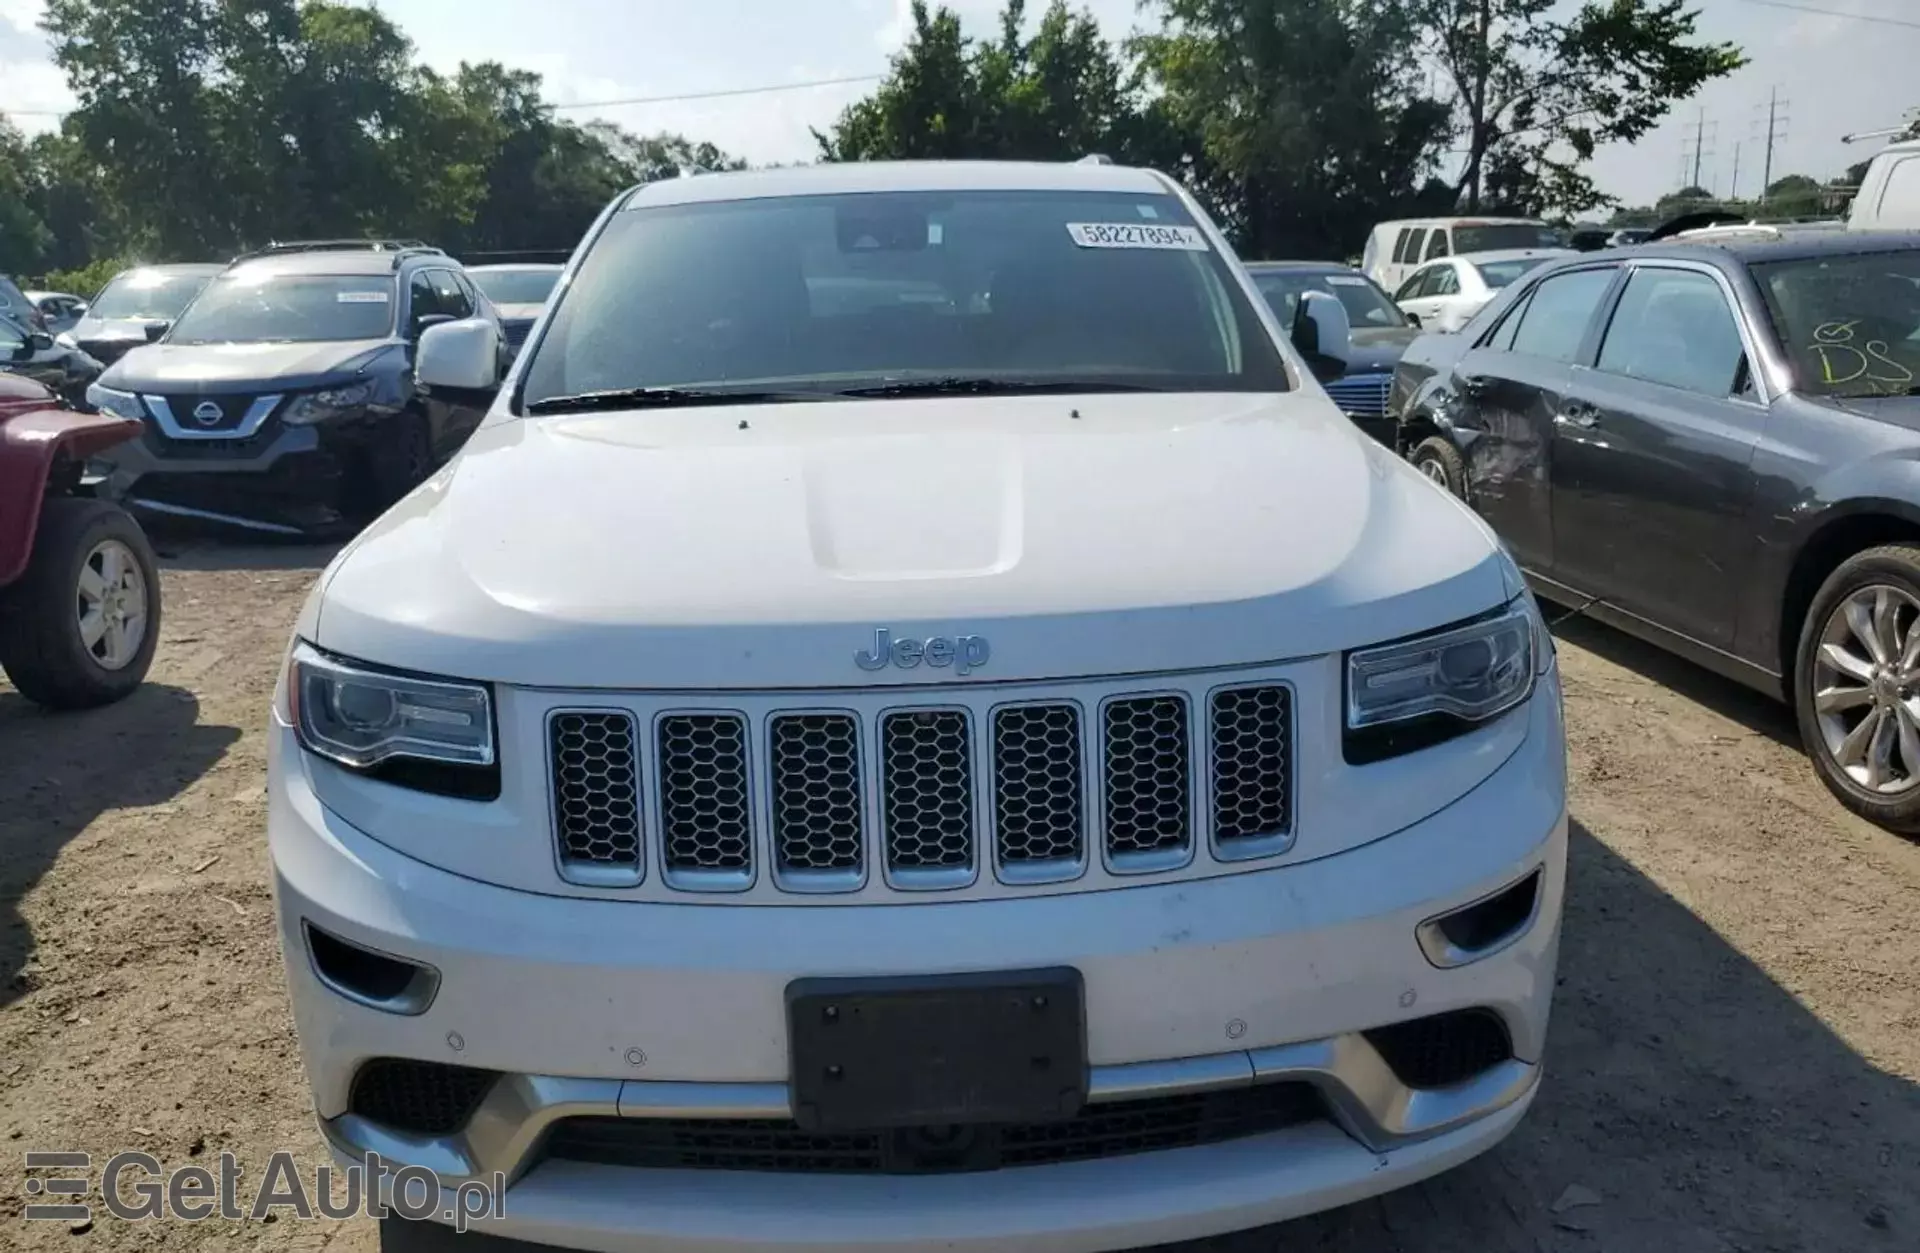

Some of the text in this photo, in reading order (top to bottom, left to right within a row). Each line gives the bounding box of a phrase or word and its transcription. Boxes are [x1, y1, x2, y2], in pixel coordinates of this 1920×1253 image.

[1082, 225, 1187, 245] 58227894
[1808, 340, 1913, 384] DS
[854, 627, 990, 676] Jeep
